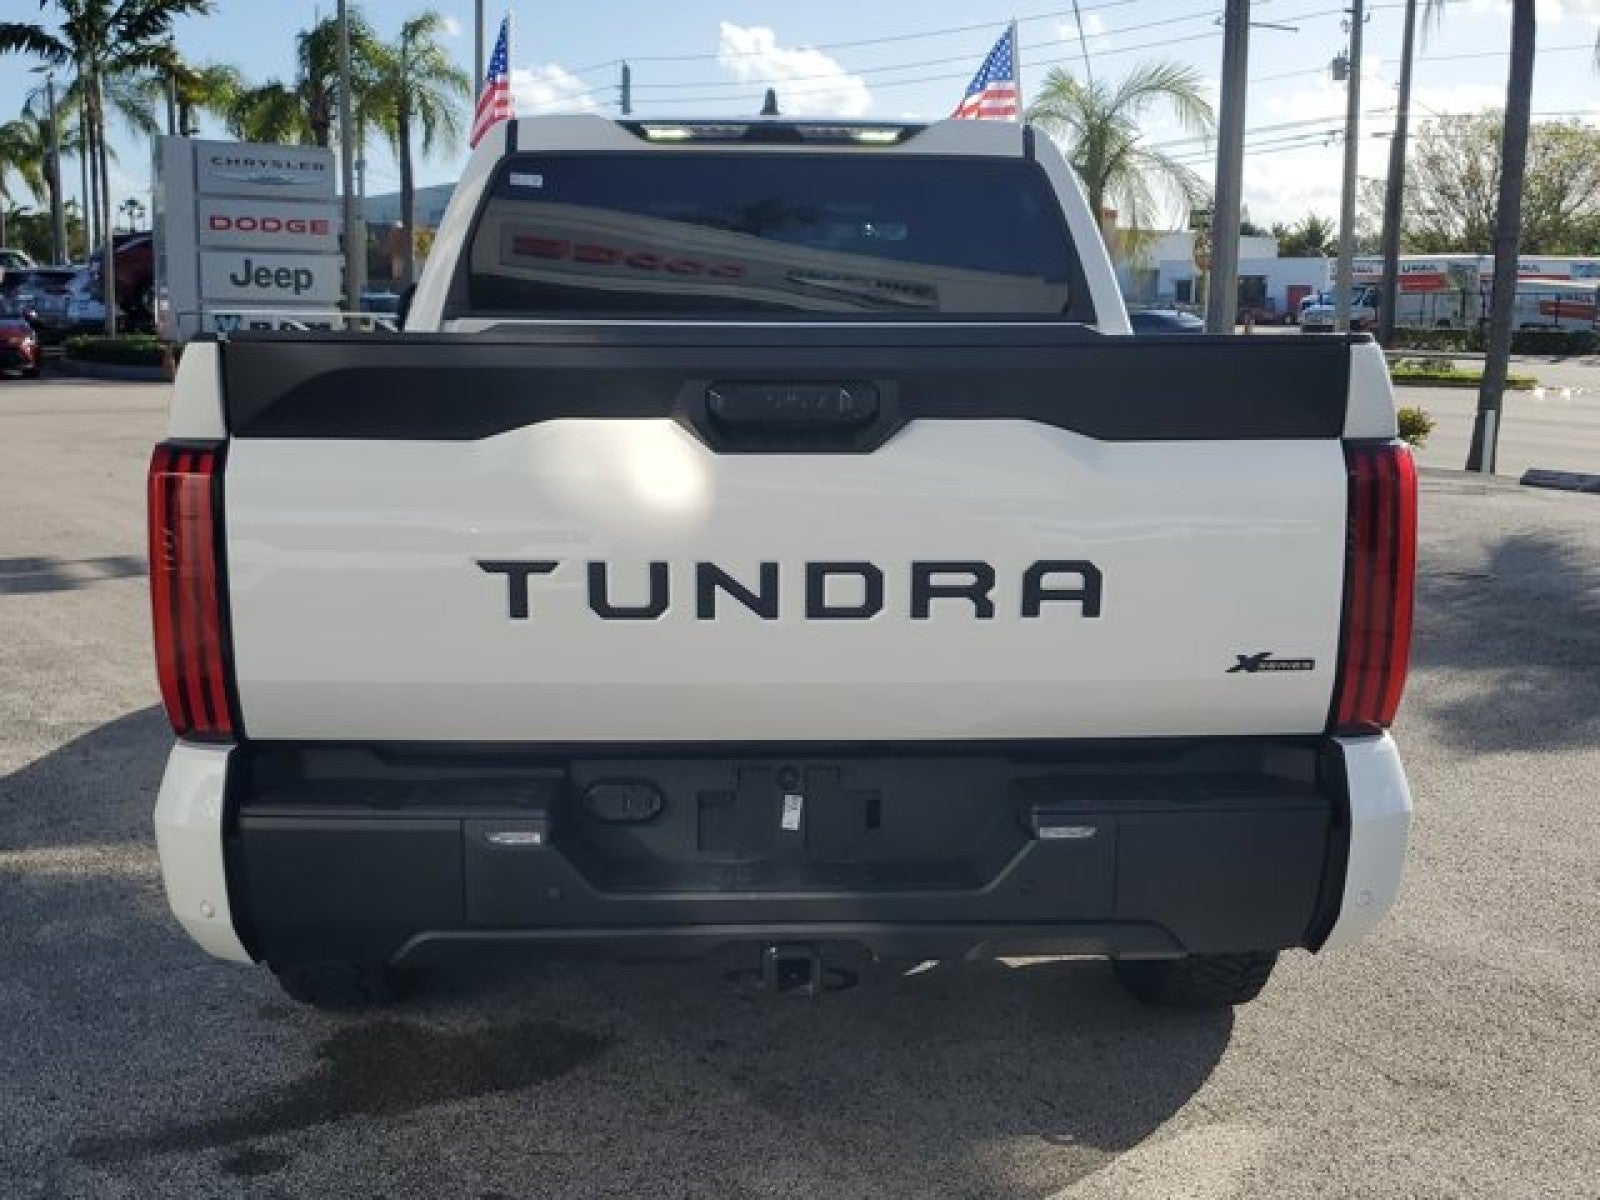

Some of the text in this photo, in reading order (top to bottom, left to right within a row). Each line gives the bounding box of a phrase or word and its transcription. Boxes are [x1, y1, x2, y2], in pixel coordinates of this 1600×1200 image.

[210, 156, 325, 171] CHRYSLER
[210, 215, 329, 236] DODGE
[229, 258, 314, 296] Jeep
[476, 560, 1104, 620] TUNDRA
